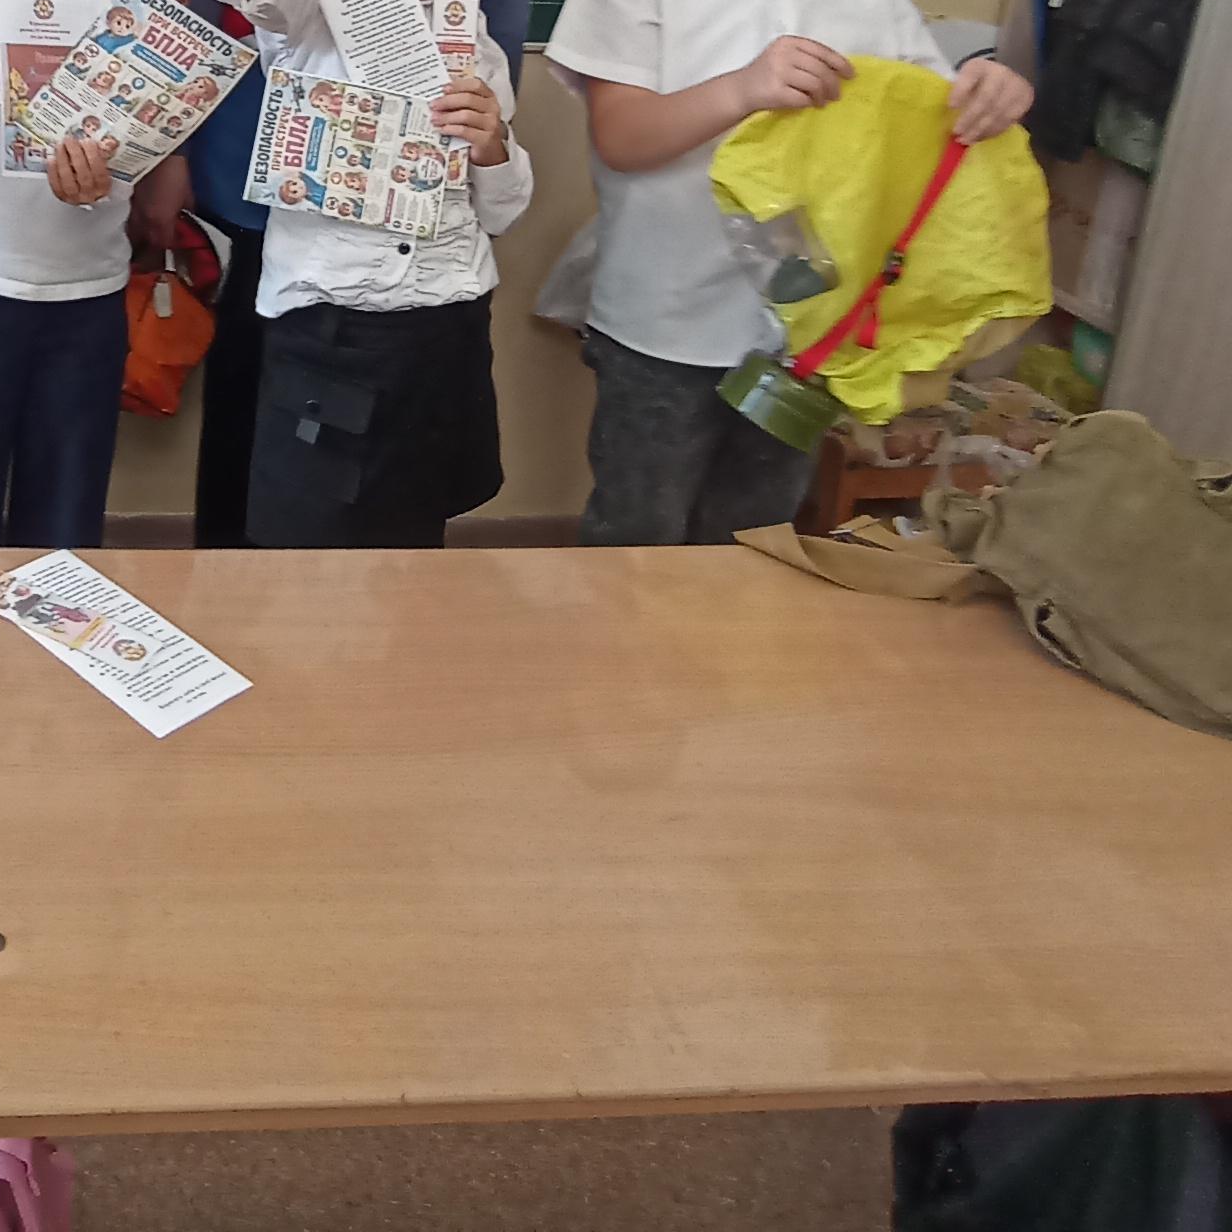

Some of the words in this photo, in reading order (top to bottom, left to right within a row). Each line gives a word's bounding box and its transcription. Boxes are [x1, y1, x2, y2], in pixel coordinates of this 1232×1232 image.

[142, 26, 198, 71] БПЛА
[148, 12, 171, 30] ПРИ
[170, 27, 214, 58] ВСТРЕЧЕ
[254, 89, 283, 184] БЕЗОПАСНОСТЬ
[274, 106, 292, 148] ВСТРЕЧЕ
[284, 115, 311, 168] БПЛА
[271, 151, 282, 171] ПРИ
